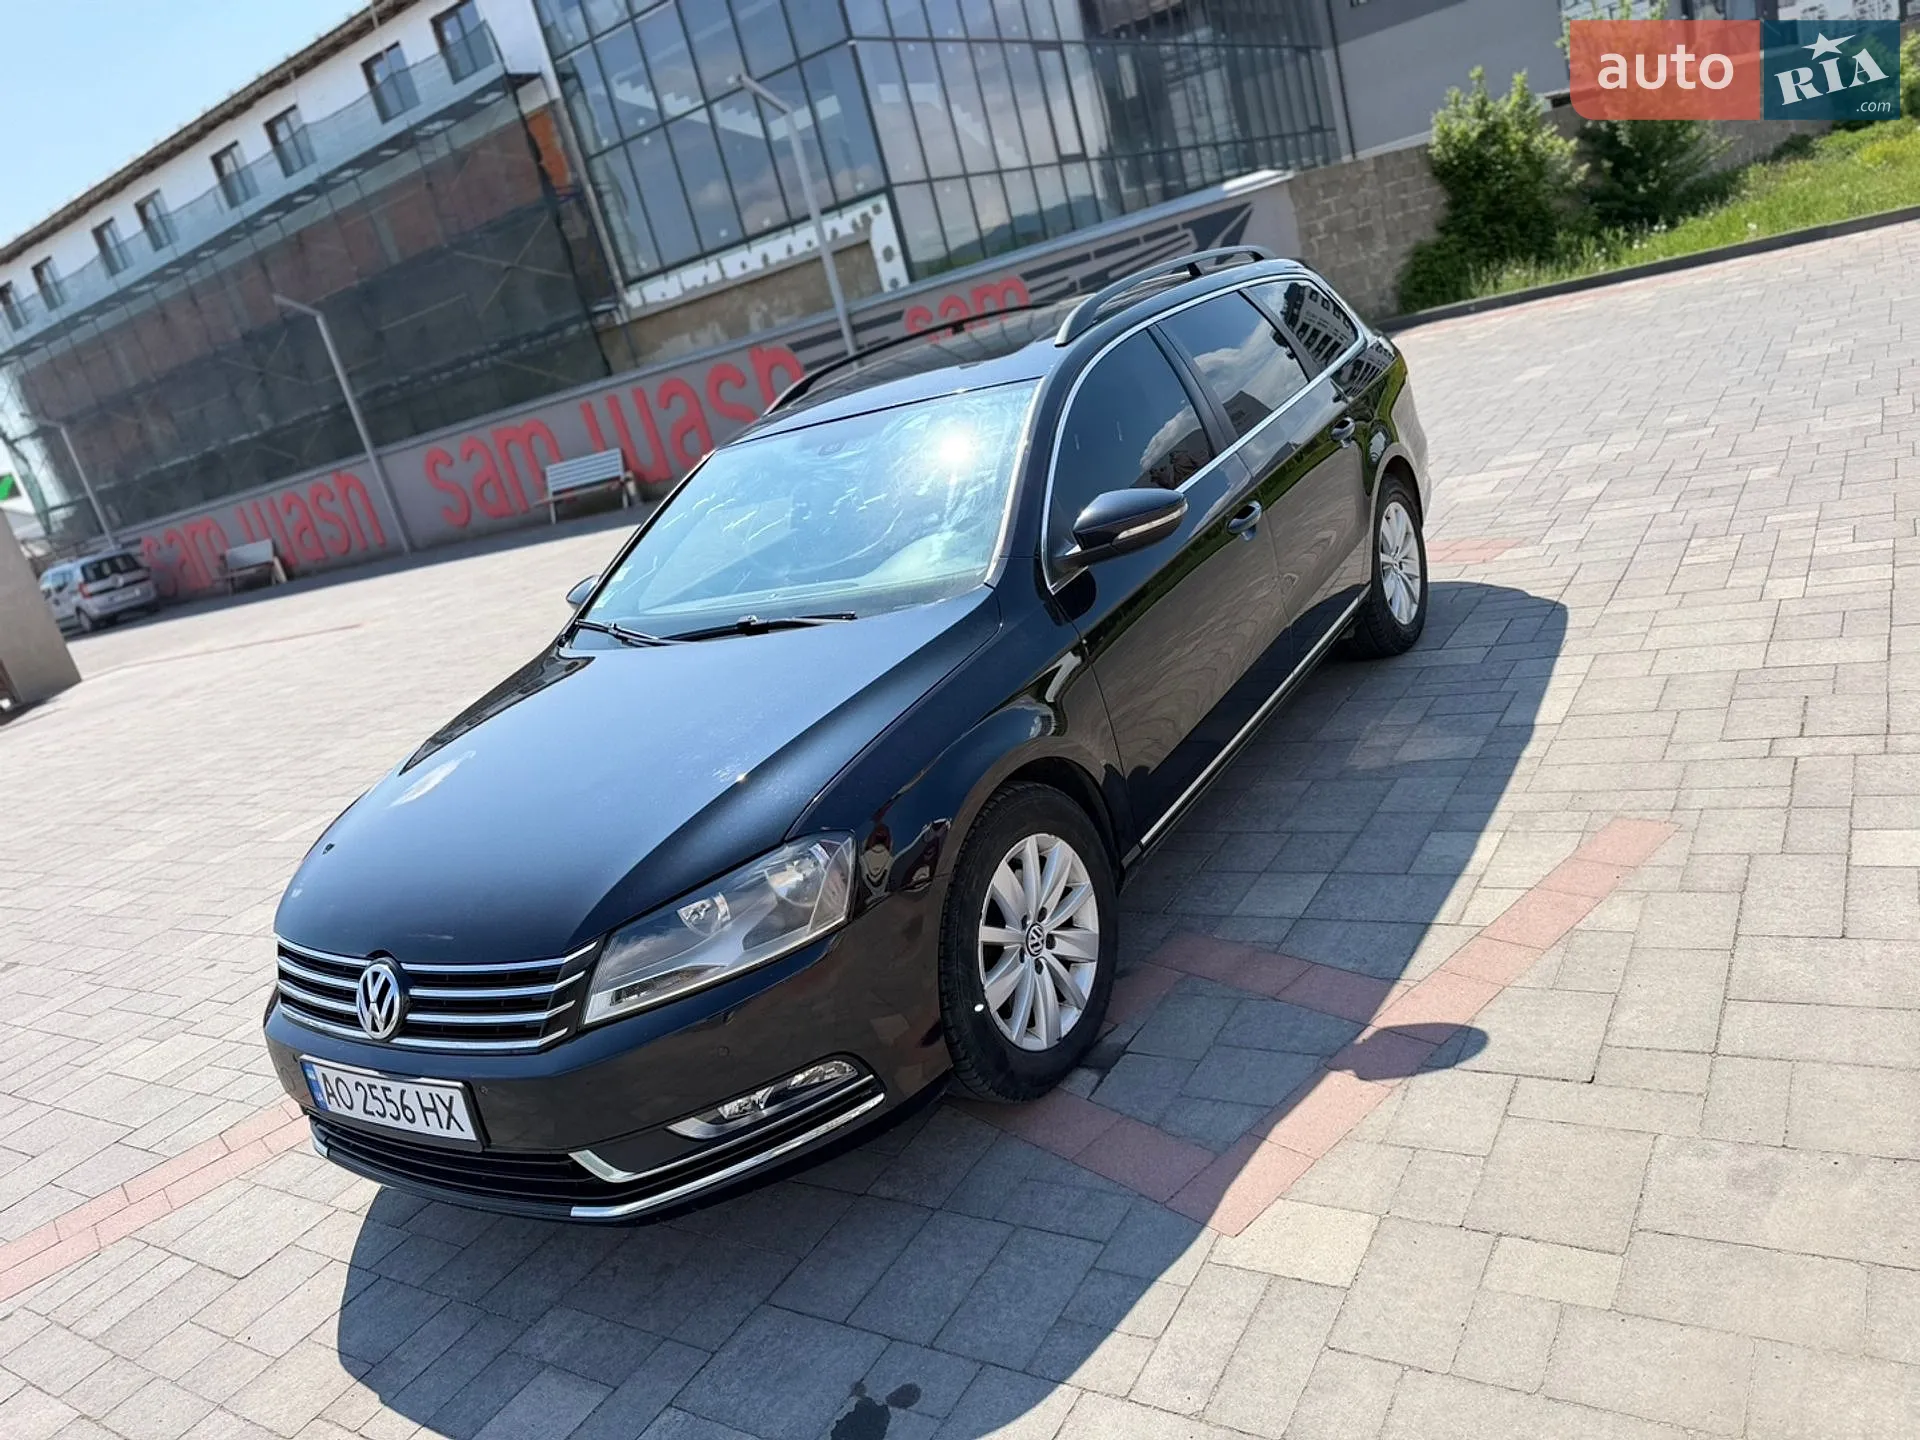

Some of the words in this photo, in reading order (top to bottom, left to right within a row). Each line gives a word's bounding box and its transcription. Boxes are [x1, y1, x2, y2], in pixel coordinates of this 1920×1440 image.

[424, 417, 567, 527] sam
[321, 1072, 354, 1110] AO
[355, 1081, 416, 1124] 2556
[415, 1091, 465, 1132] HX
